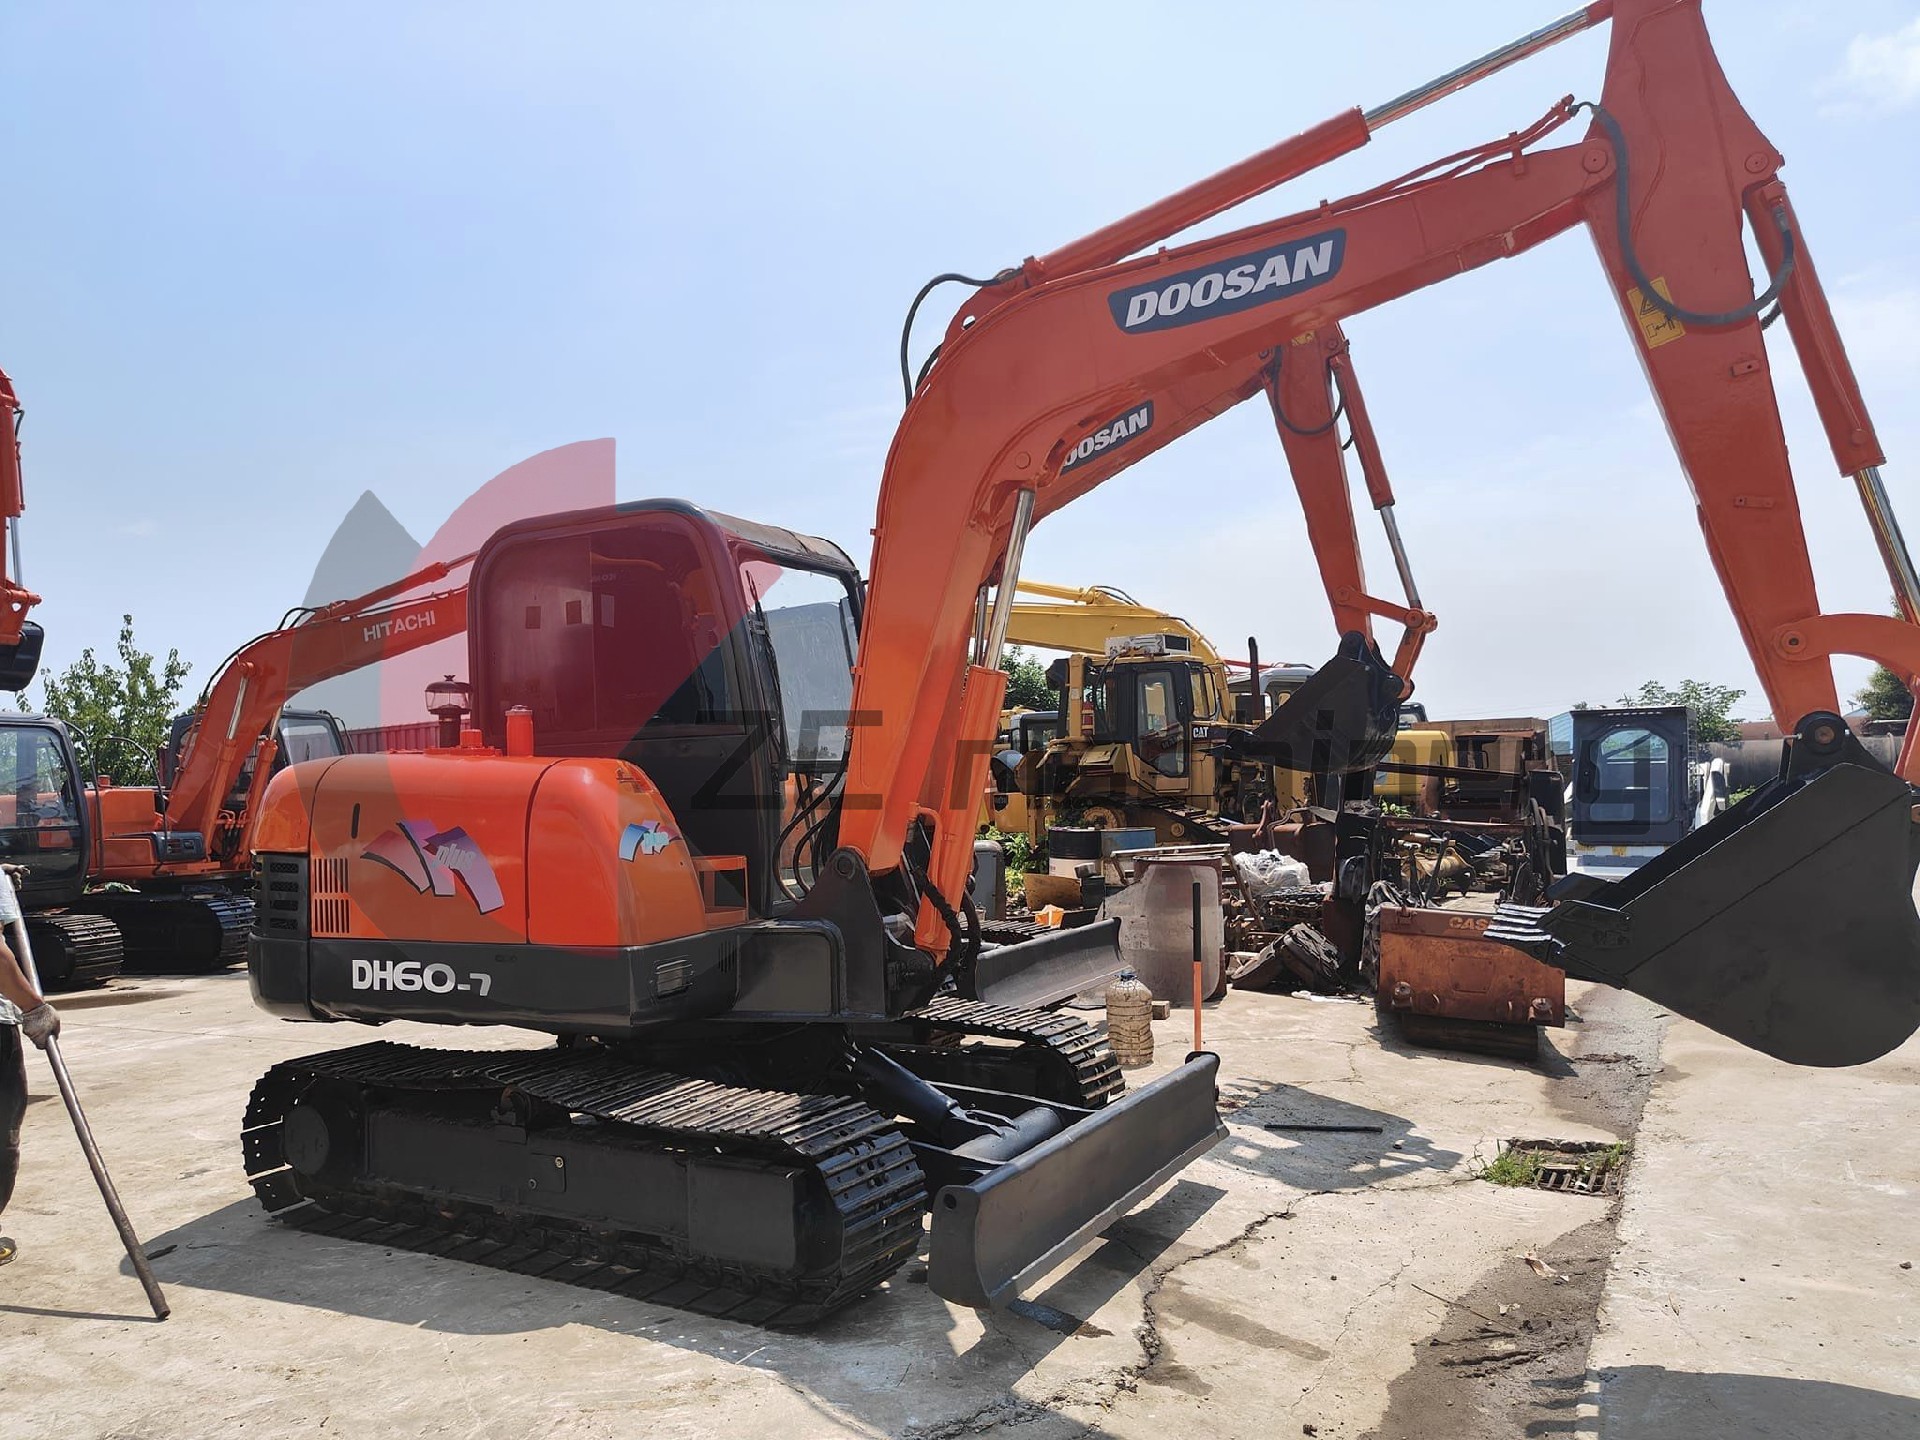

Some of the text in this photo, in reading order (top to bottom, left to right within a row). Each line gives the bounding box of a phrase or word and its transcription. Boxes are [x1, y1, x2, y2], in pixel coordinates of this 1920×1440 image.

[1125, 240, 1334, 328] DOOSAN
[1063, 407, 1148, 467] OOSAN
[363, 610, 436, 642] HITACHI
[1193, 727, 1209, 738] CAT
[1451, 917, 1490, 931] CAS
[352, 959, 492, 997] DH60-7
